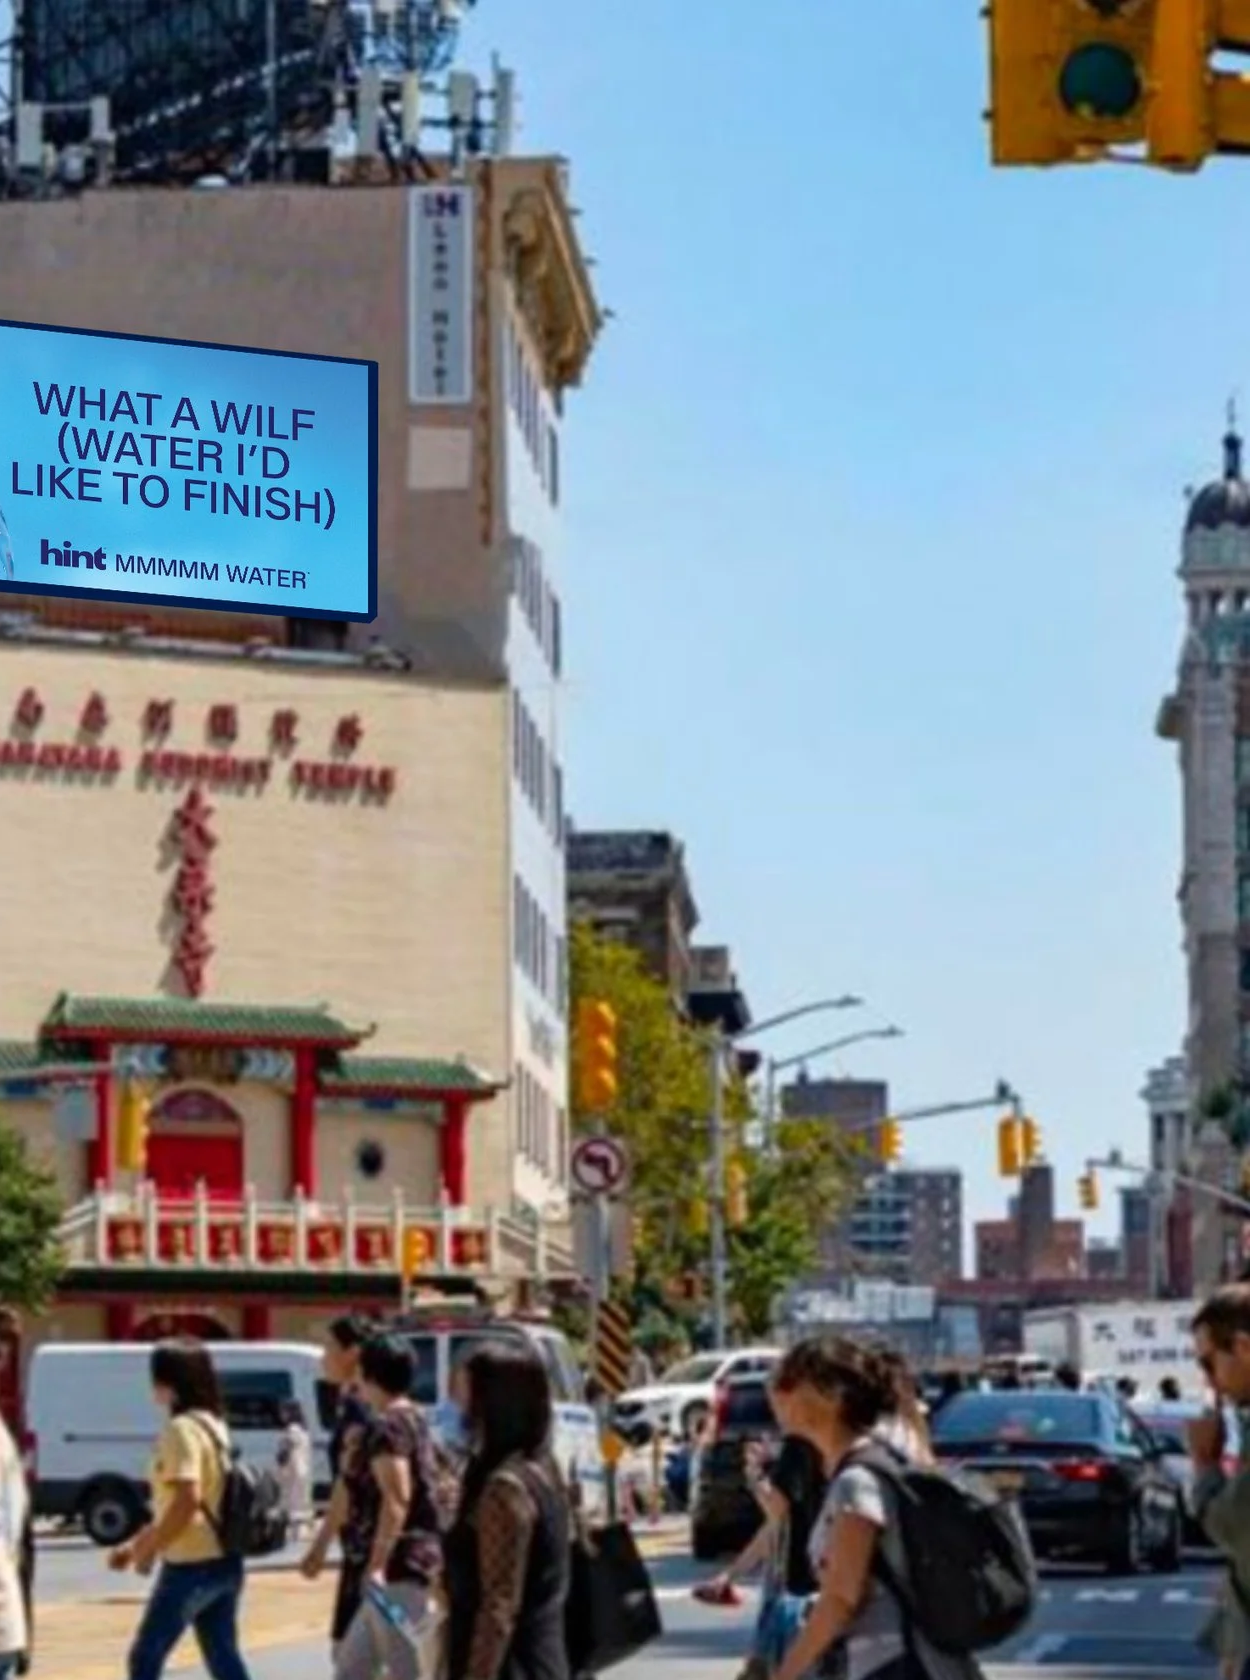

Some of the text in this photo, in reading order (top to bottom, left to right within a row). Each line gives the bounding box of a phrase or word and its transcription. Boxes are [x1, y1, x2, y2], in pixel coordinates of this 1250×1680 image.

[33, 381, 315, 441] WHAT A WILF
[58, 422, 290, 479] (WATER I'D
[12, 461, 335, 530] LIKE TO FINISH)
[40, 539, 306, 589] hint MMMMM WATER
